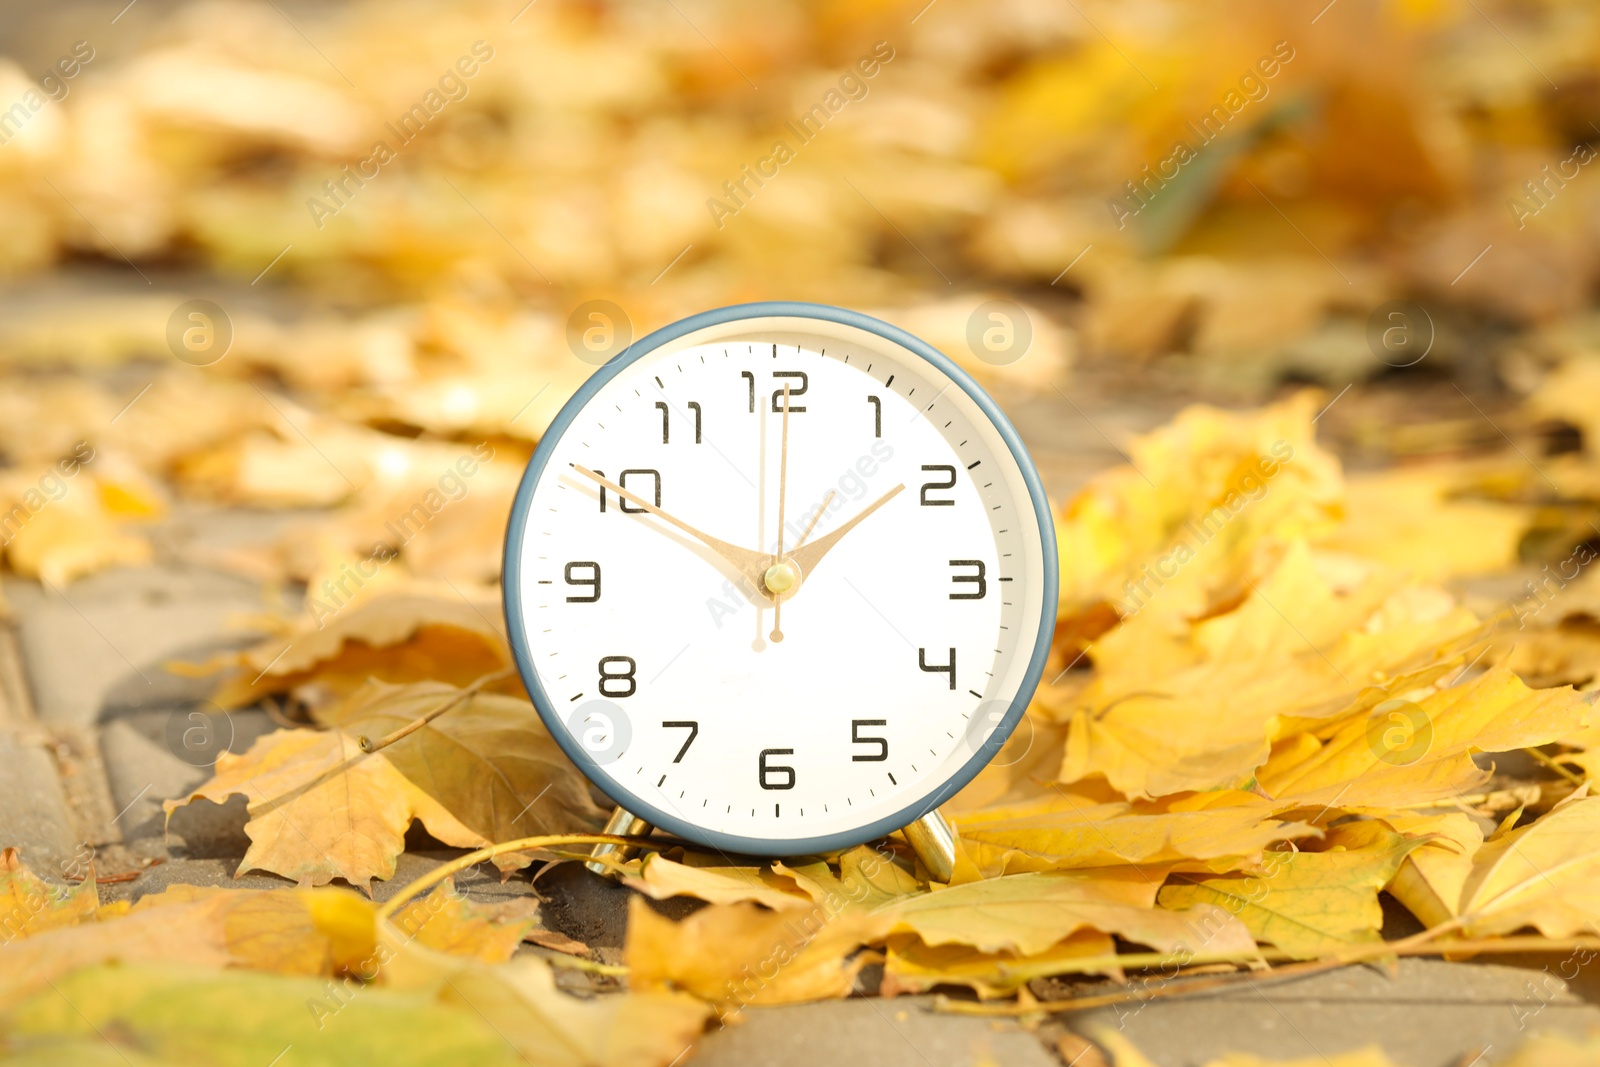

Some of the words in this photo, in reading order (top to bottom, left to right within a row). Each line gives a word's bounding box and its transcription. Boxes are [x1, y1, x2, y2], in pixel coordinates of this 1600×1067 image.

[742, 371, 808, 413] 12
[655, 402, 702, 444] 11
[867, 395, 882, 438] 1
[592, 469, 661, 513] 10
[920, 465, 957, 506] 2
[565, 562, 601, 603] 9
[949, 560, 987, 600] 3
[598, 656, 637, 698] 8
[919, 647, 957, 690] 4
[662, 721, 699, 764] 7
[852, 719, 889, 762] 5
[759, 749, 796, 790] 6
